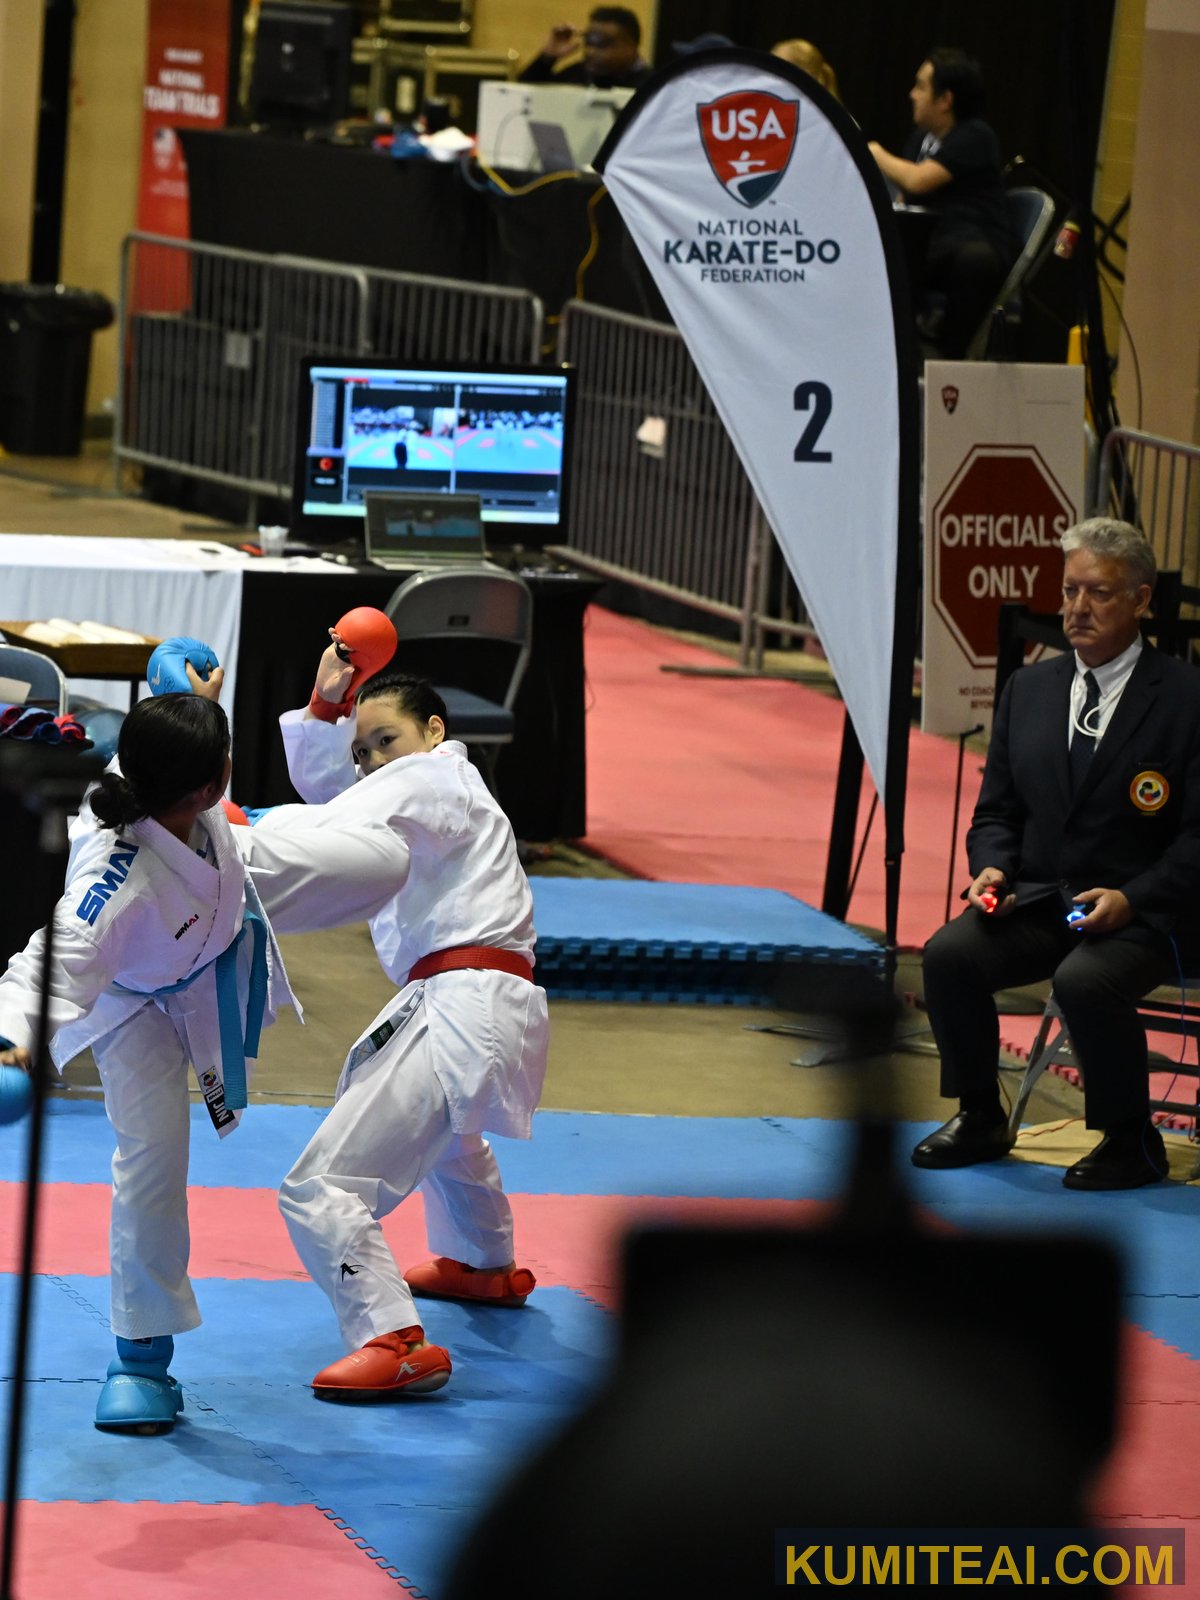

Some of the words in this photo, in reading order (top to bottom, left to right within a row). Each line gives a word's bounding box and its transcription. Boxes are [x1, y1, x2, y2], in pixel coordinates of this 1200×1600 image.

[711, 107, 786, 141] USA
[698, 219, 803, 236] NATIONAL
[663, 239, 841, 265] KARATE-DO
[700, 268, 805, 283] FEDERATION
[793, 381, 833, 463] 2
[941, 513, 1067, 548] OFFICIALS
[968, 565, 1039, 598] ONLY
[76, 839, 140, 927] SMAI
[174, 914, 199, 940] SMAI
